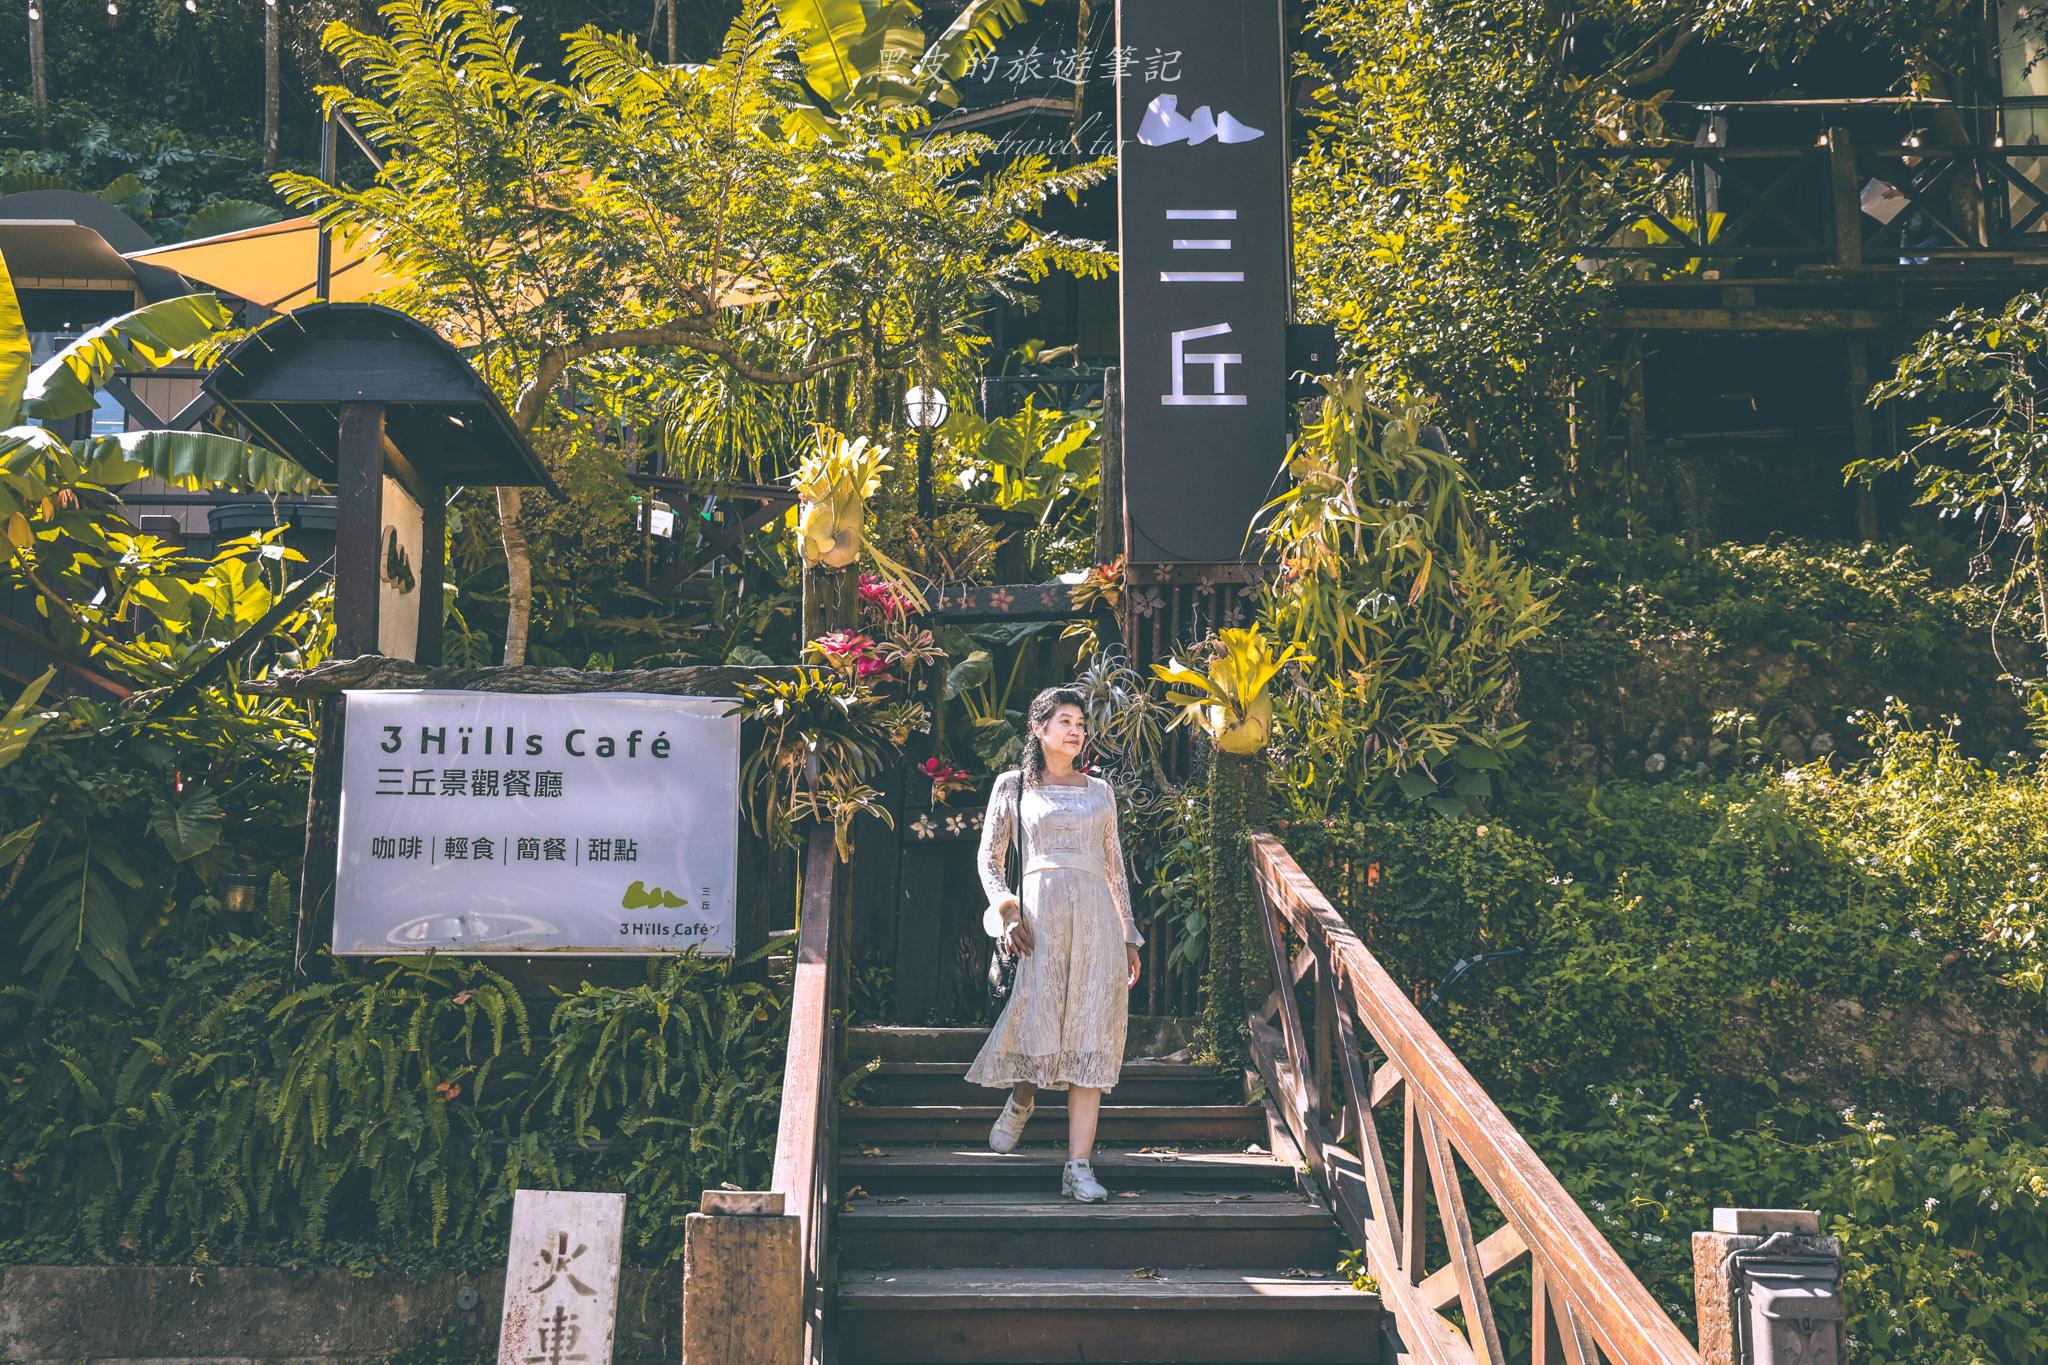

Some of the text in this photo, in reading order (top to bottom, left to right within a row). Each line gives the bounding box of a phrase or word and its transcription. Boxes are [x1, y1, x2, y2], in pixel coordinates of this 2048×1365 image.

[1160, 209, 1248, 406] 三丘
[380, 726, 671, 759] 3 Hïlls Café
[375, 768, 563, 798] 三丘景觀餐廳
[371, 836, 638, 862] 咖啡 輕食 簡餐 甜點
[620, 923, 629, 935] 3
[673, 923, 709, 936] Café
